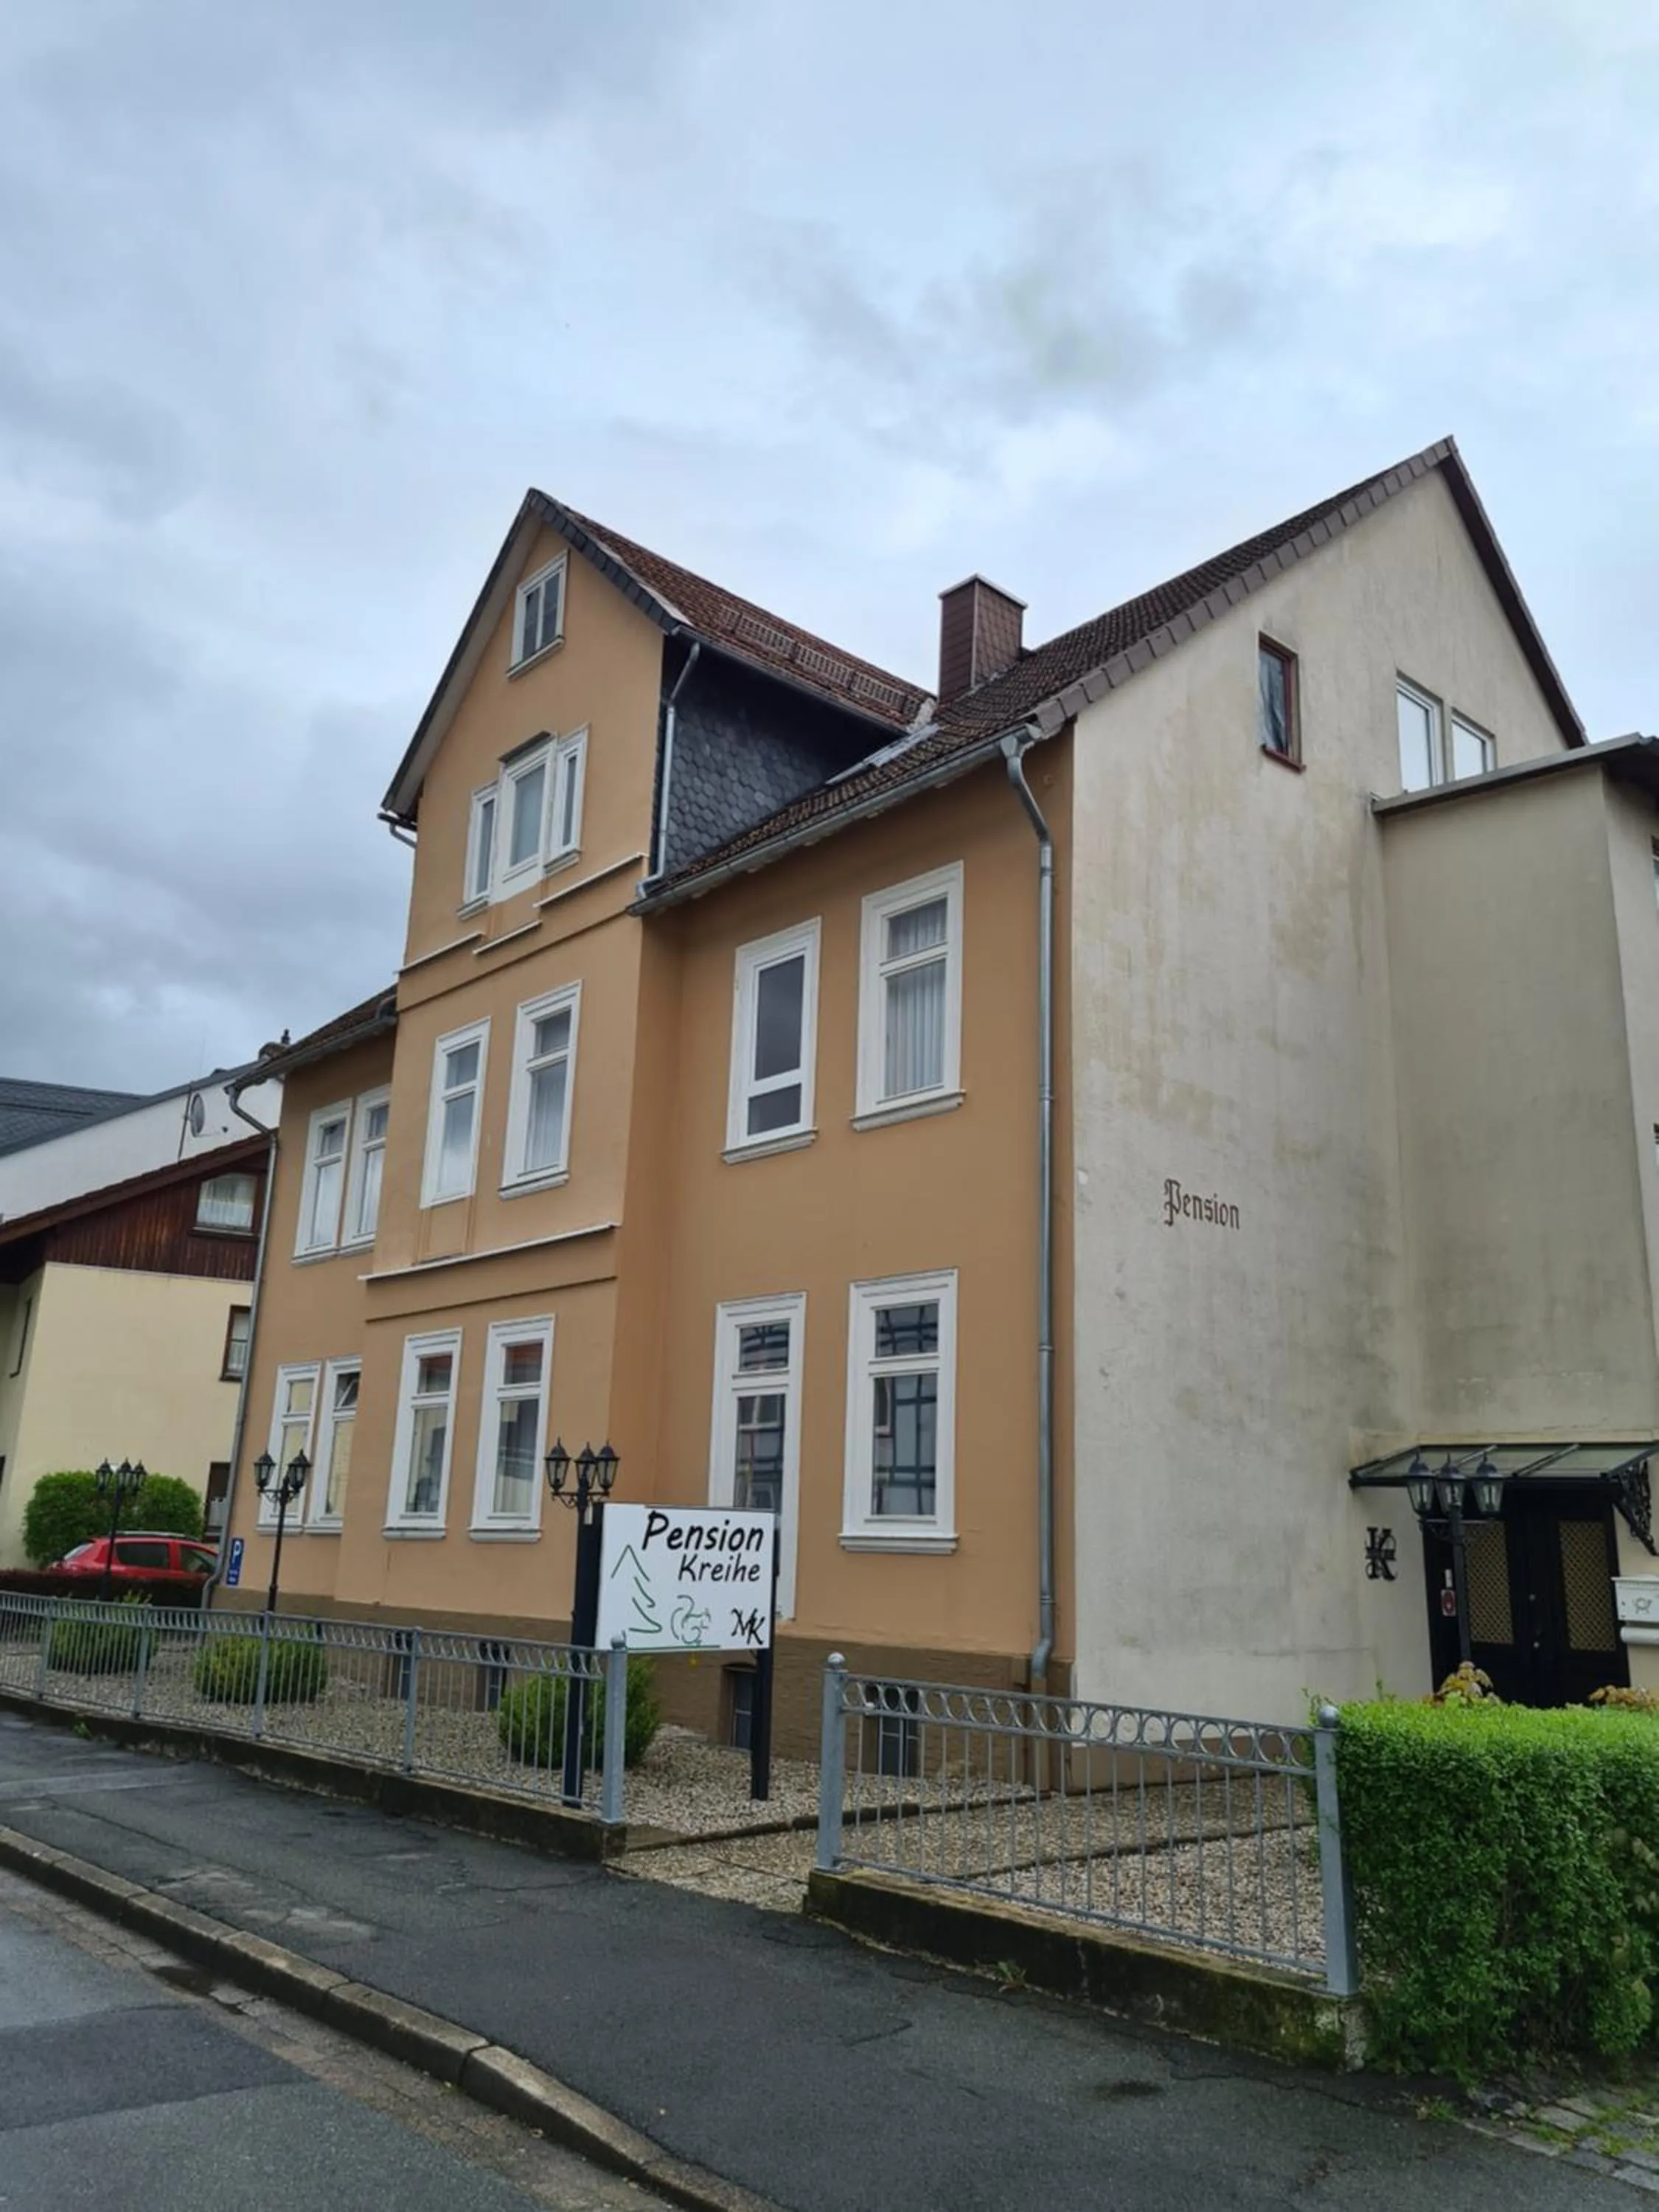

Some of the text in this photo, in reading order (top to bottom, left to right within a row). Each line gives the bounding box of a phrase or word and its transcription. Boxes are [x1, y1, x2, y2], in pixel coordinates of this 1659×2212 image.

[1164, 1178, 1239, 1230] Pension
[642, 1510, 764, 1551] Pension
[232, 1540, 243, 1564] P
[678, 1553, 761, 1582] Kreihe
